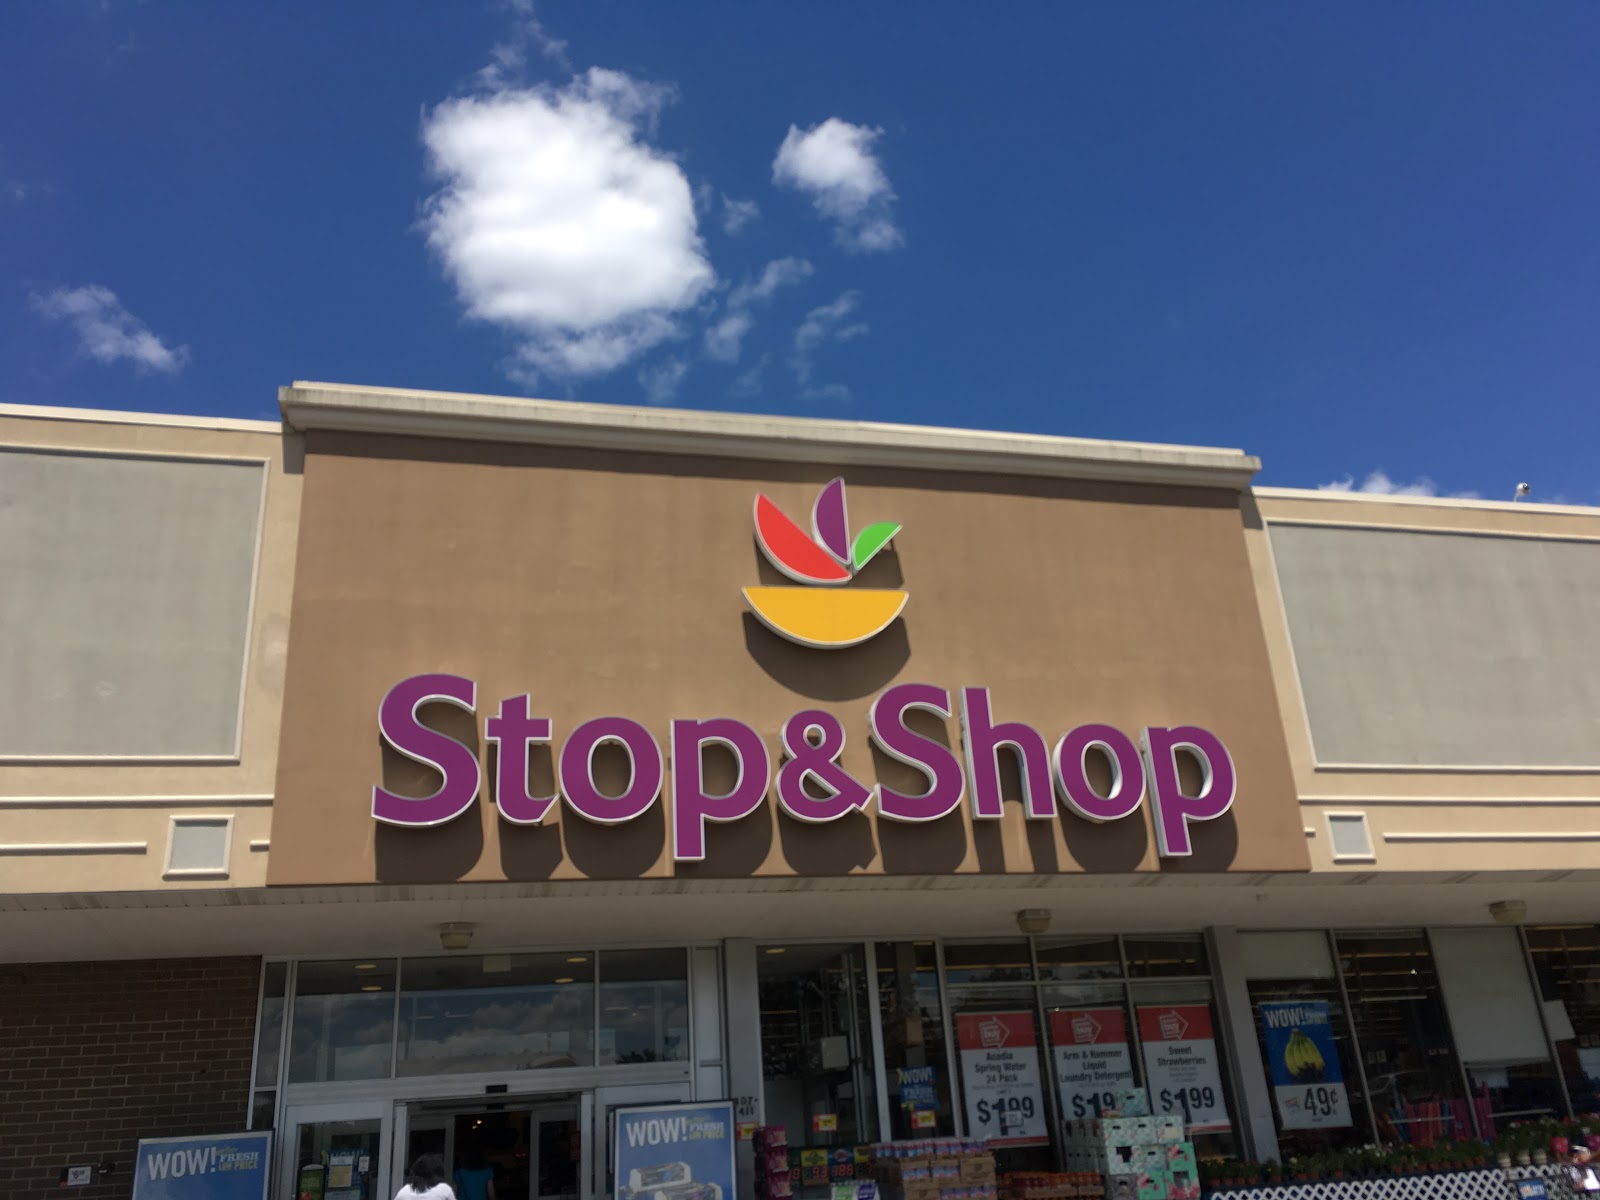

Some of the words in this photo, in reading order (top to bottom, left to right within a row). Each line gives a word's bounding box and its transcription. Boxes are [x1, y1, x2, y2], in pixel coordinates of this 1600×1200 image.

[1263, 1007, 1305, 1029] WOW!
[1063, 1051, 1080, 1060] Arm
[1082, 1051, 1088, 1059] &
[1090, 1049, 1122, 1059] Hammer
[1168, 1046, 1192, 1055] Sweet
[986, 1052, 1014, 1061] Acadia
[1157, 1057, 1207, 1067] Strawberries
[974, 1064, 1002, 1073] Spring
[1003, 1063, 1027, 1071] Water
[1082, 1061, 1107, 1070] Liquid
[986, 1075, 996, 1083] 24
[998, 1074, 1018, 1083] Pack
[1060, 1073, 1092, 1083] Laundry
[1094, 1070, 1132, 1082] Detergent
[625, 1116, 688, 1148] WOW!
[220, 1151, 260, 1162] FRESH
[147, 1146, 216, 1181] WOW!
[234, 1159, 259, 1170] PRICE
